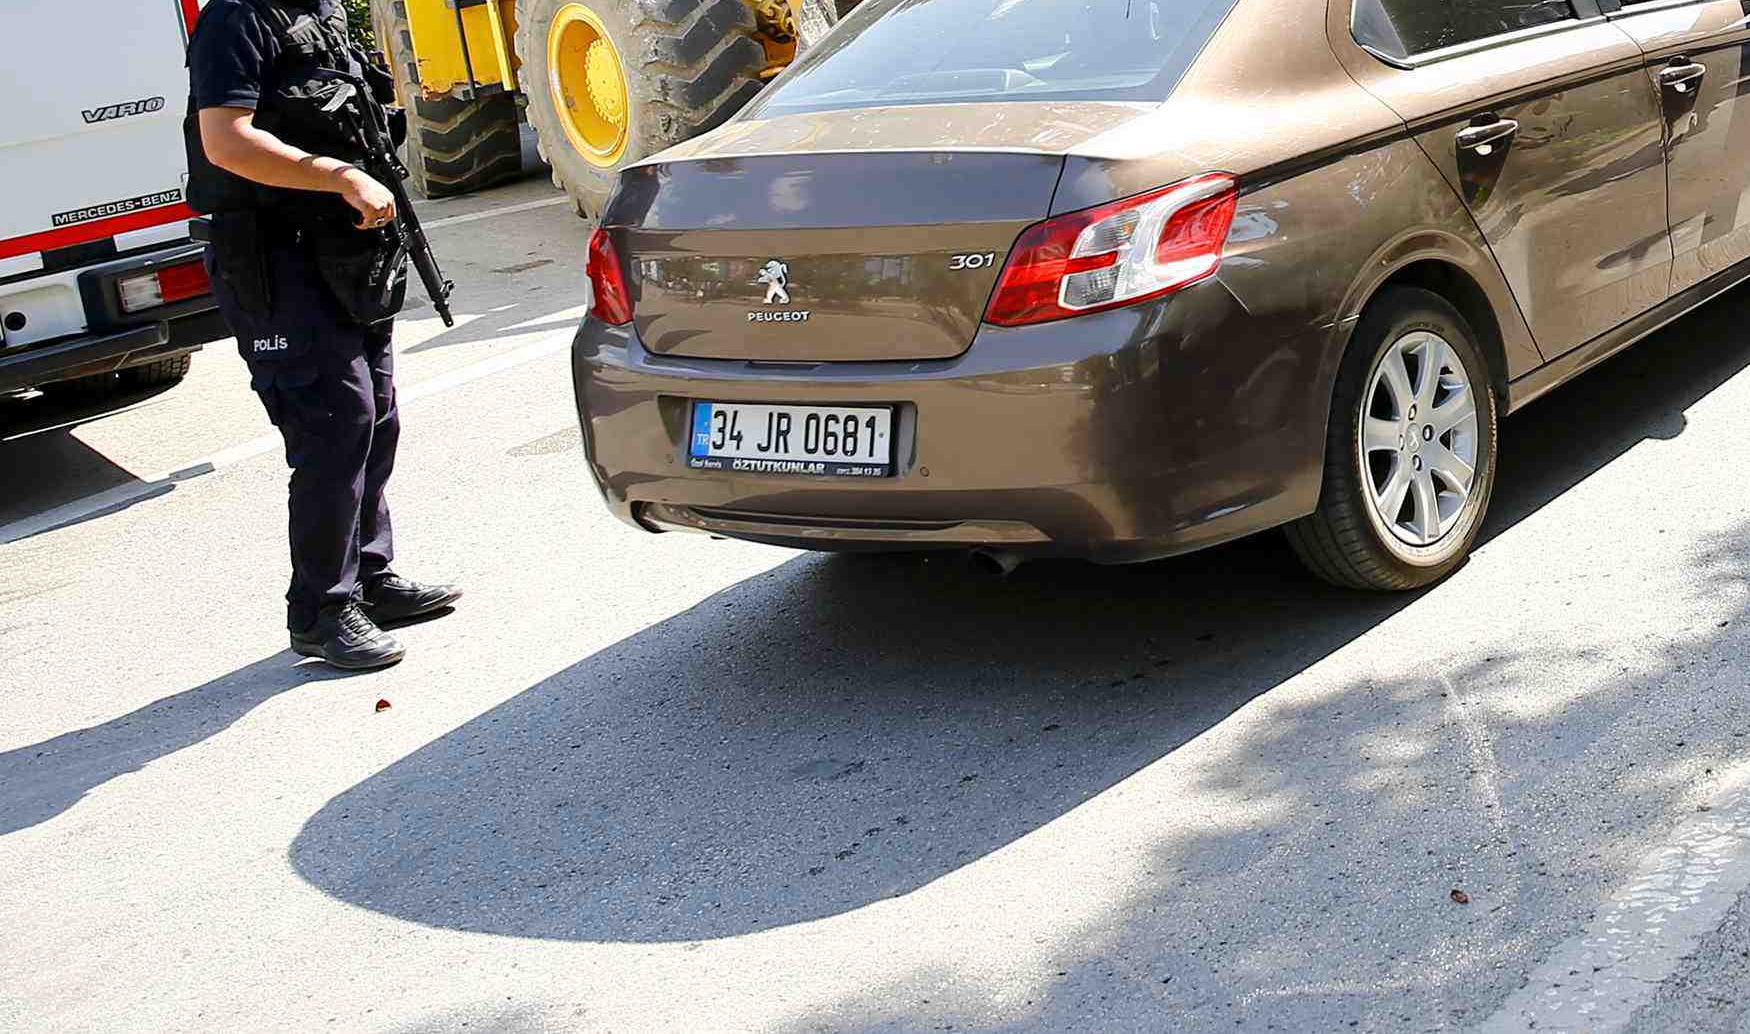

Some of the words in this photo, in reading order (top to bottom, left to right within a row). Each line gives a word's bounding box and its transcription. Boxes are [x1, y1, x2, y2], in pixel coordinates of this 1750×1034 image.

[81, 96, 165, 124] VARIO
[53, 190, 181, 225] MERCEDES-BENZ
[949, 252, 996, 270] 301
[747, 310, 810, 322] PEUGEOT
[254, 334, 289, 352] POLİS
[697, 432, 709, 446] TR
[712, 409, 744, 451] 34
[757, 411, 792, 454] JR
[804, 412, 876, 458] 0681
[732, 457, 826, 475] ÖZTUTKUNLAR
